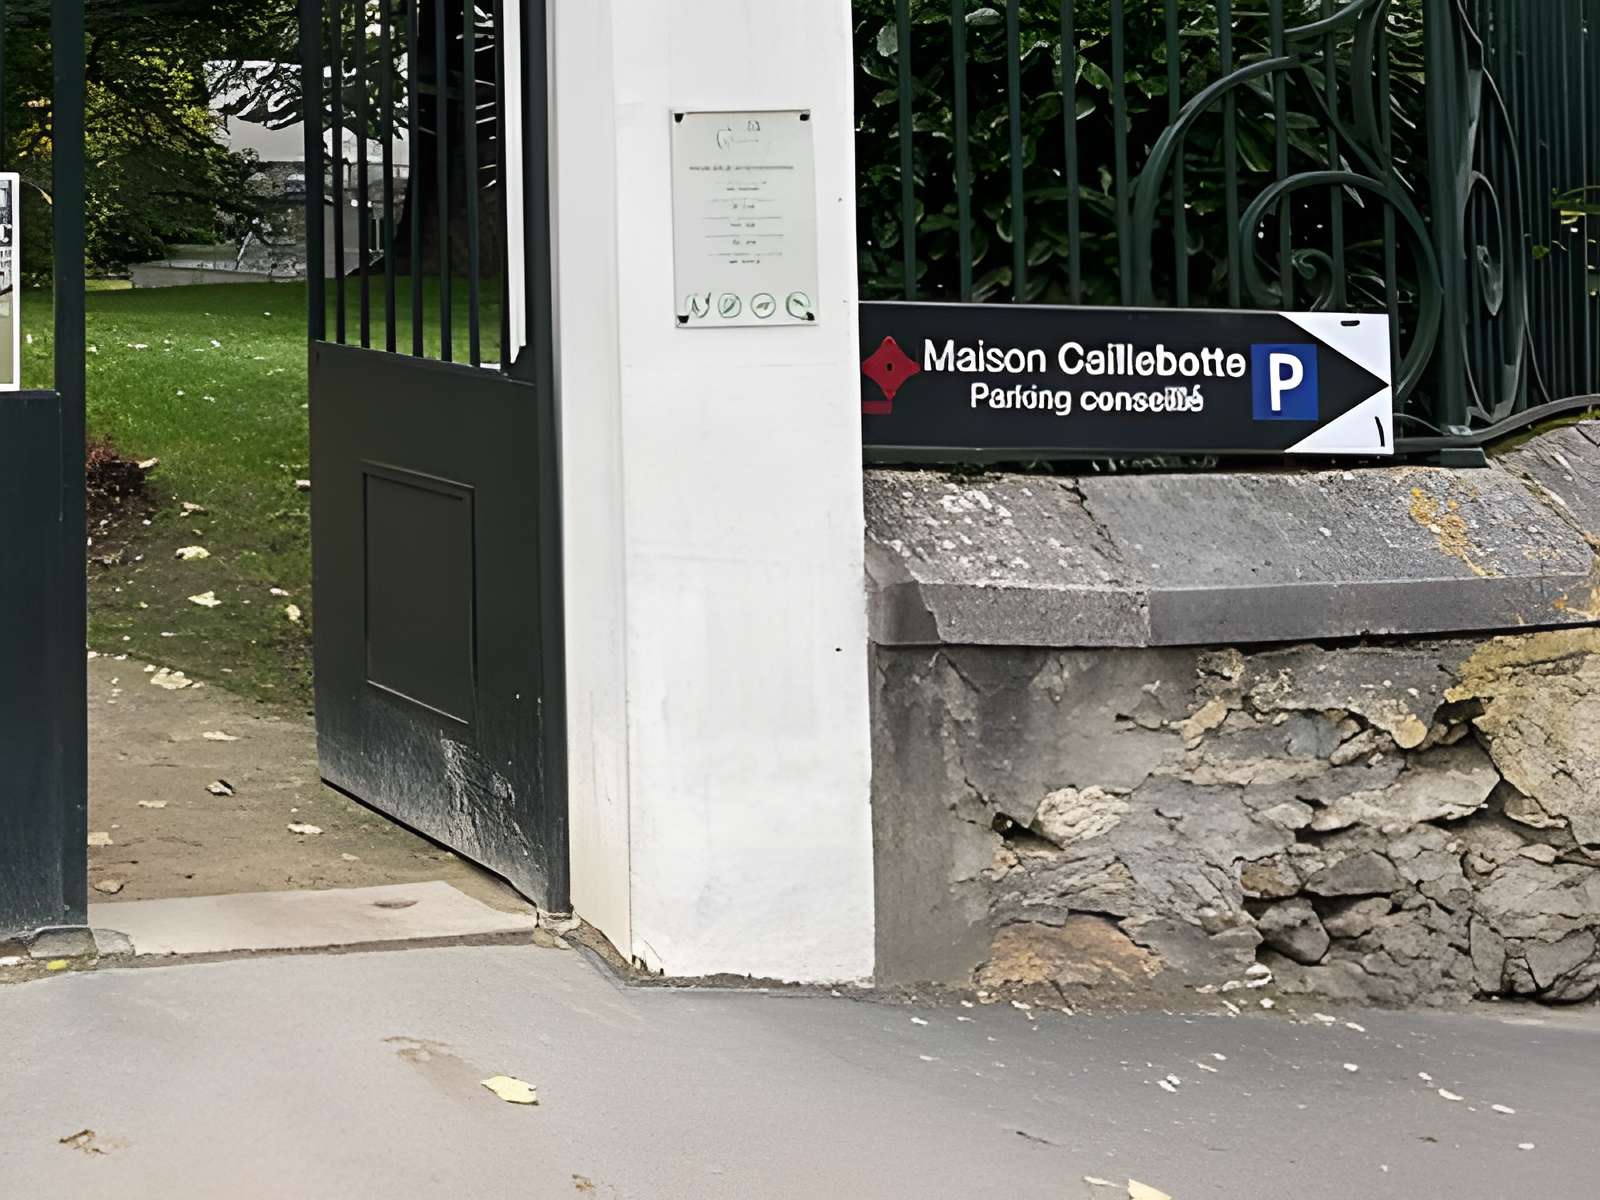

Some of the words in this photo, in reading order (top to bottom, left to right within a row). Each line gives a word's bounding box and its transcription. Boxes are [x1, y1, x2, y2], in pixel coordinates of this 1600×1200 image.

[923, 338, 1047, 374] Maison
[1057, 341, 1246, 378] Caillebotte
[970, 382, 1072, 416] Parking
[1269, 353, 1304, 411] P
